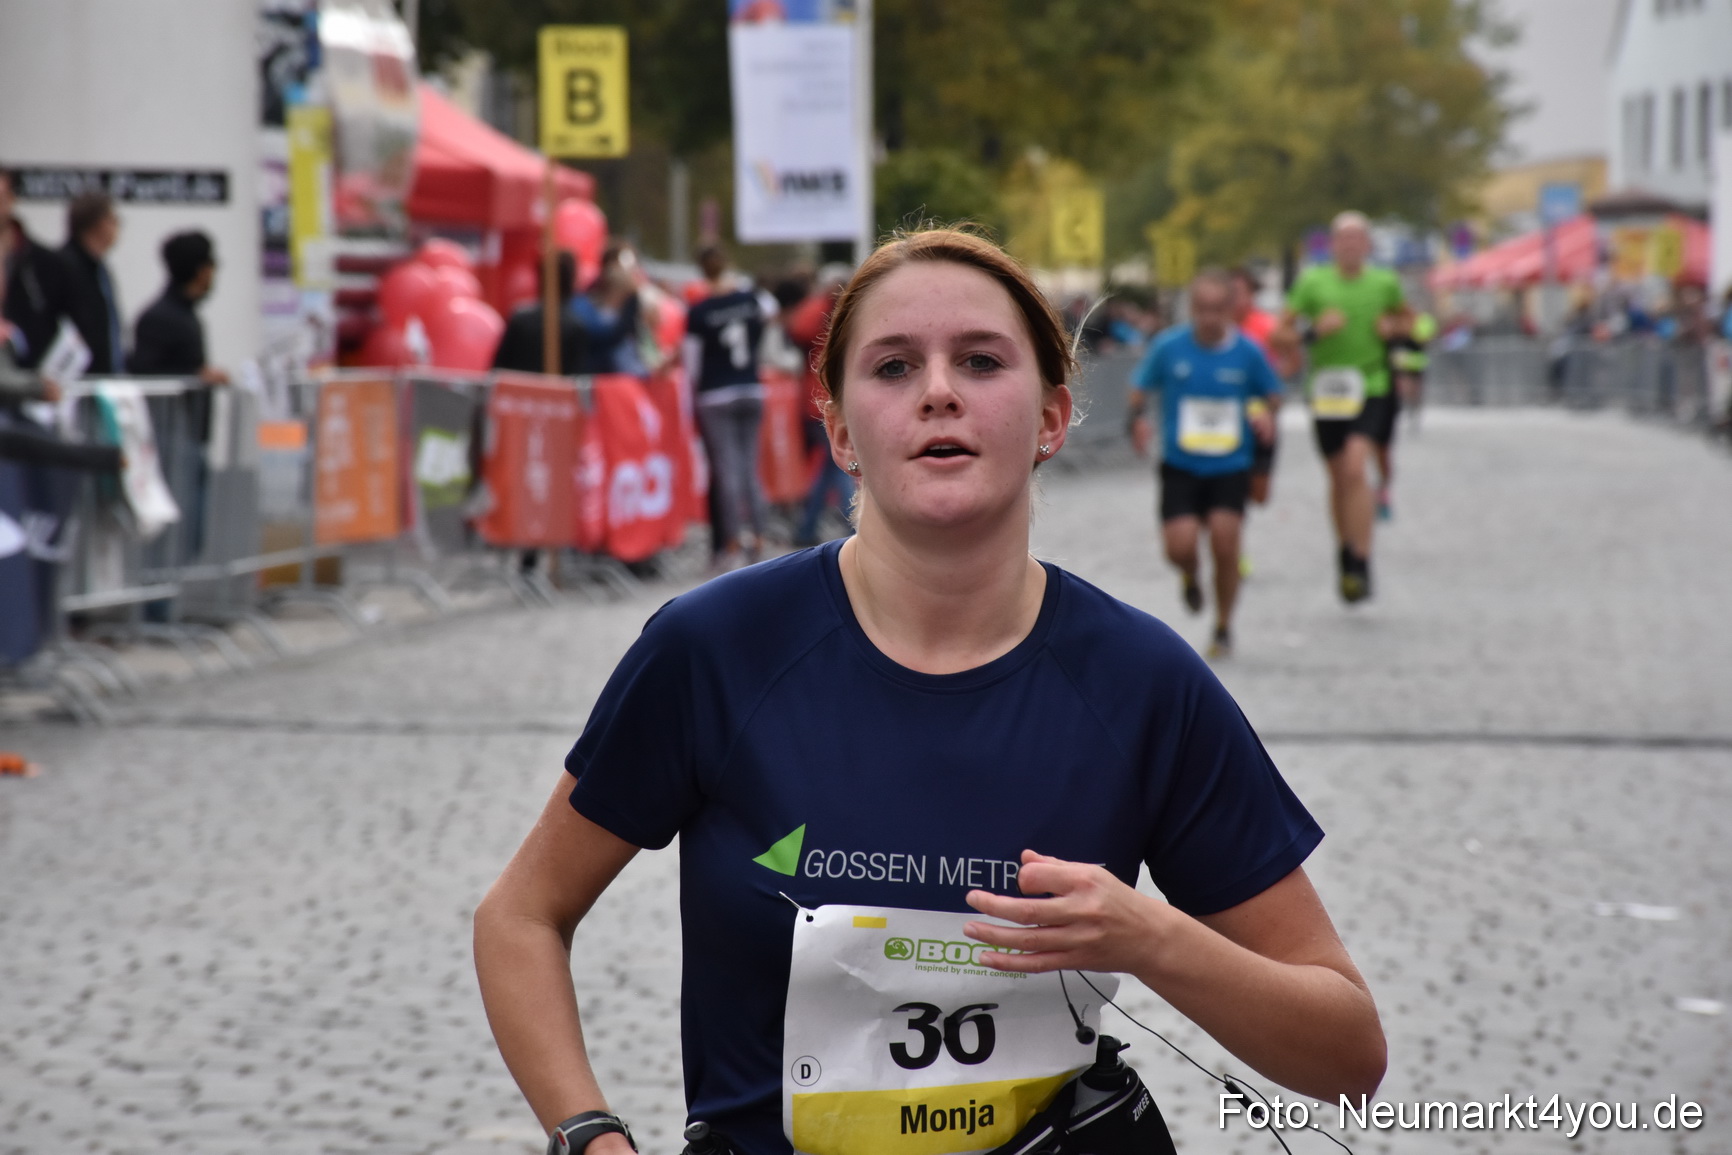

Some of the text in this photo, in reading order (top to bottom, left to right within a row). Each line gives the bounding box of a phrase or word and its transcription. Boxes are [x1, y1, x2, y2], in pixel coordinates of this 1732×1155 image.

[566, 69, 604, 126] B
[804, 849, 927, 884] GOSSEN
[915, 963, 1028, 980] inspired by smart concepts
[889, 1002, 999, 1070] 36
[801, 1063, 812, 1080] D
[901, 1099, 994, 1136] Monja
[1132, 1092, 1150, 1122] ZIKEE
